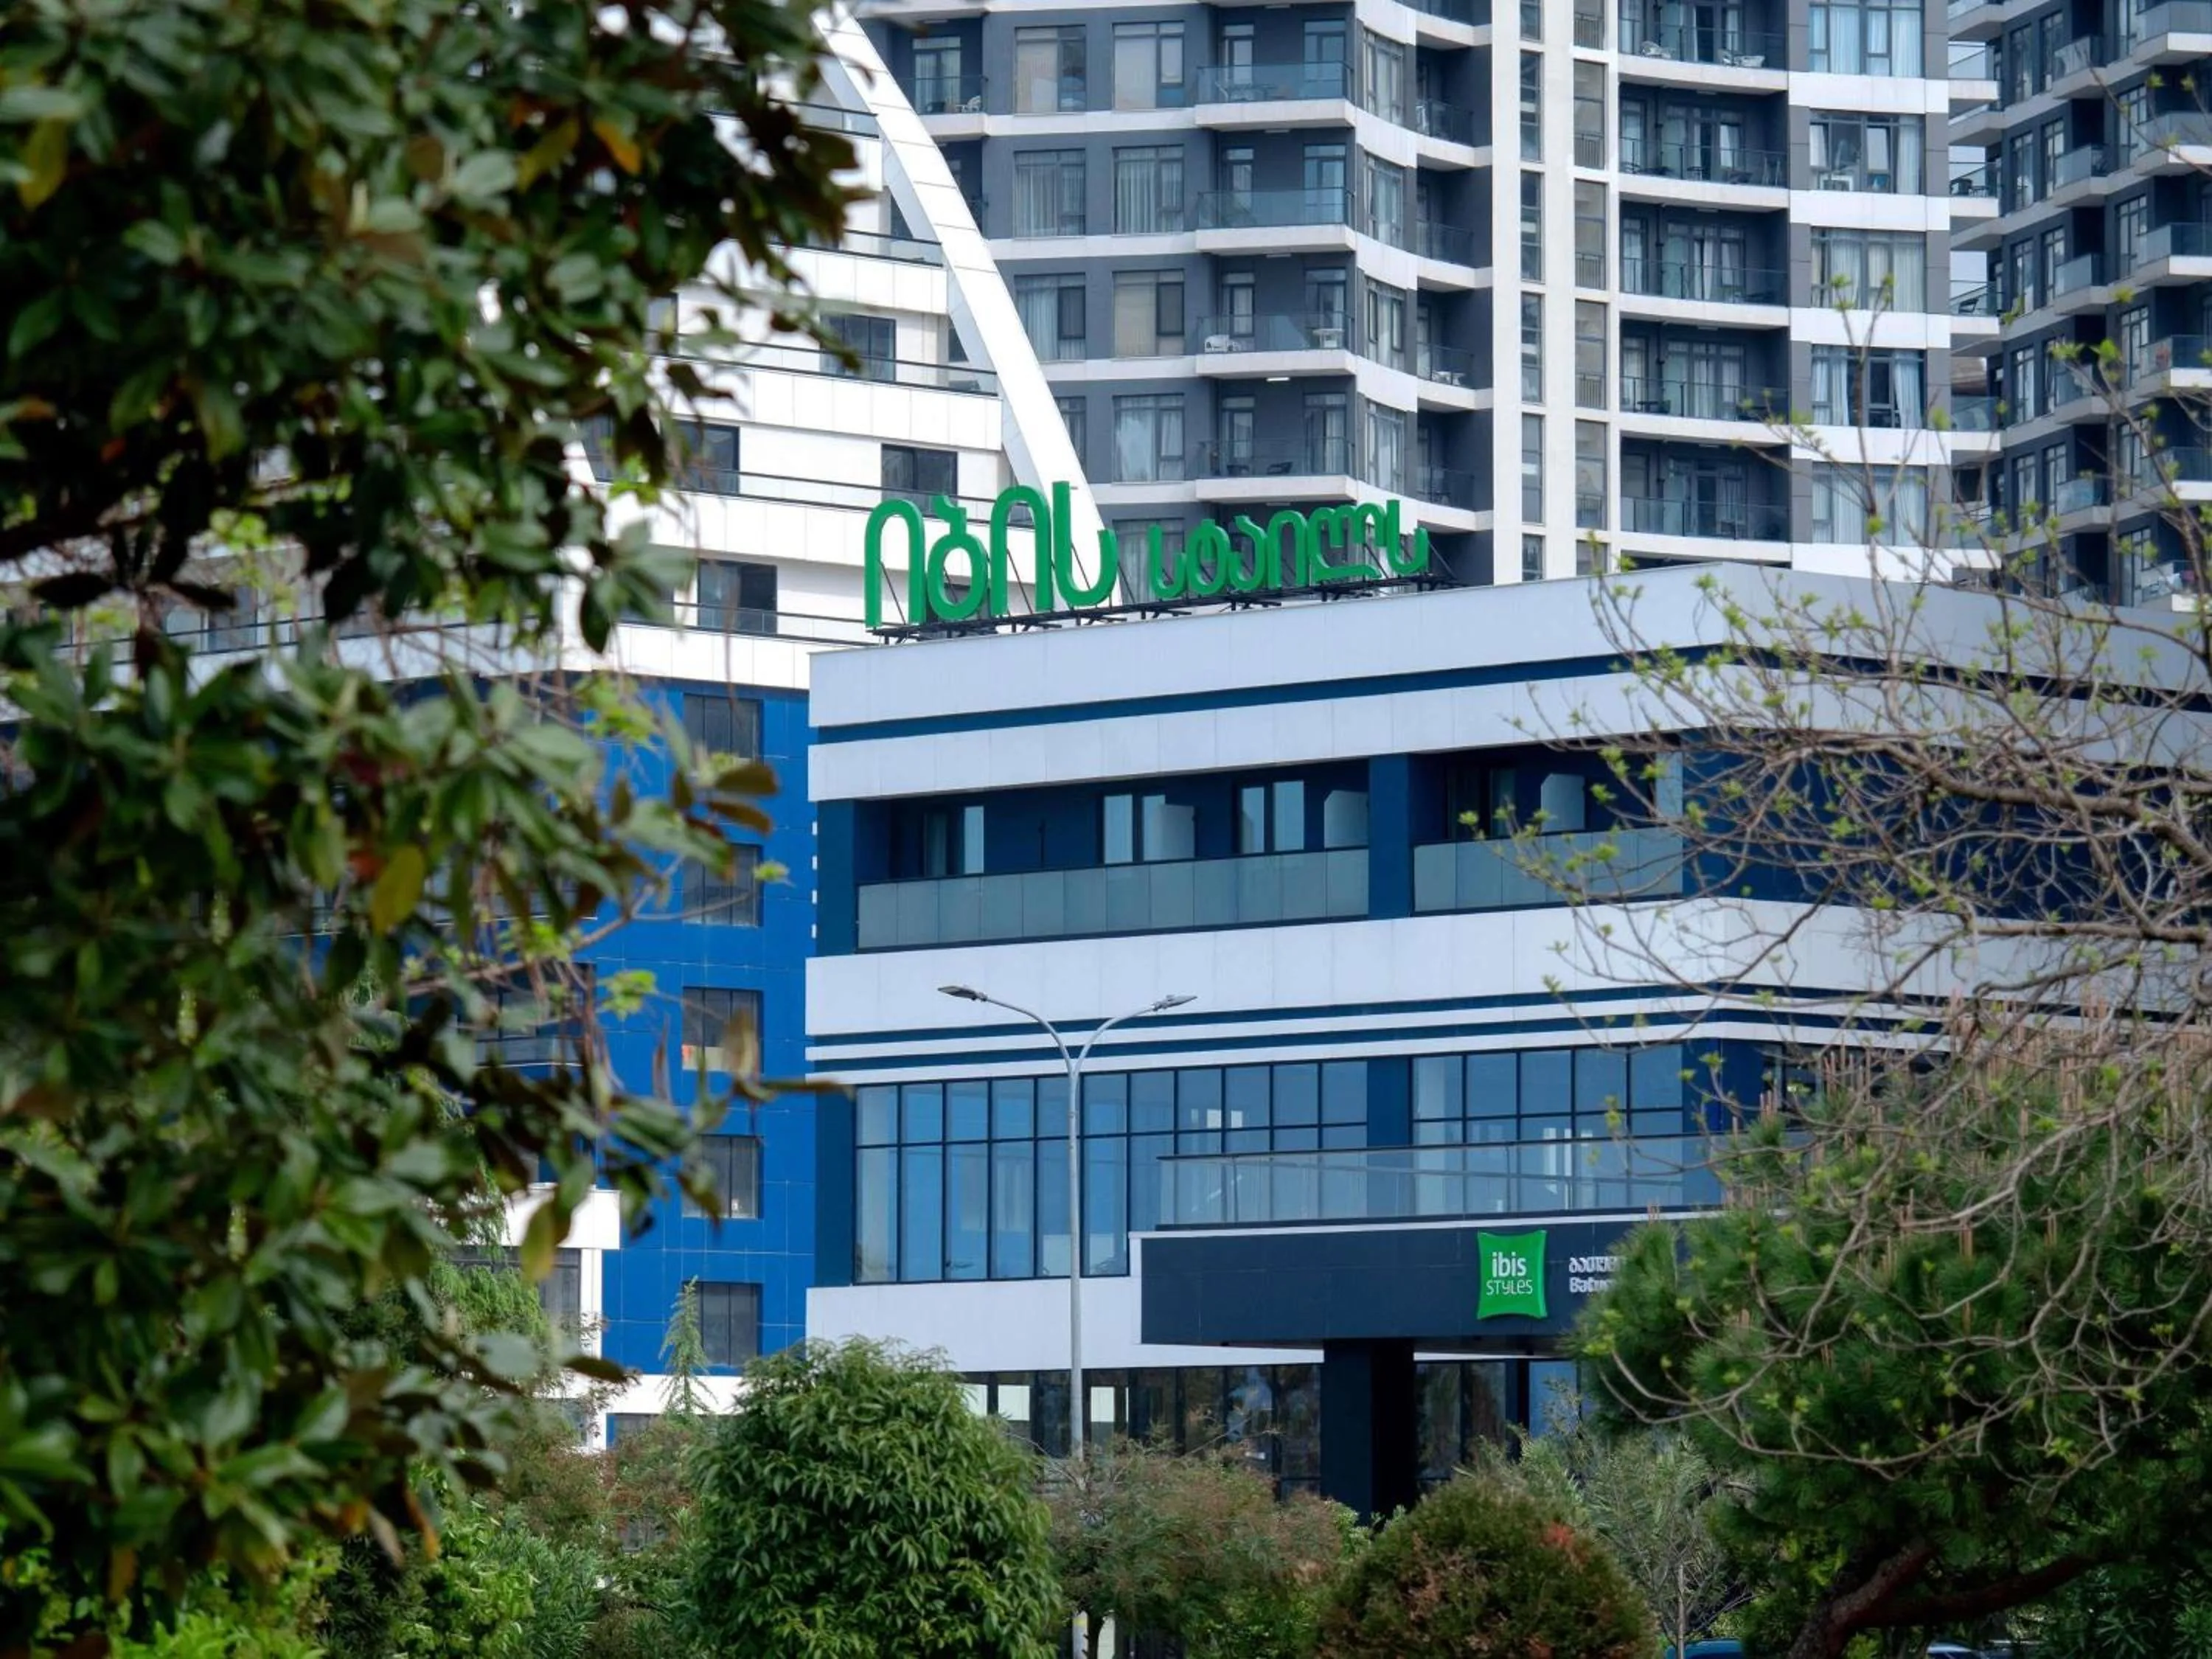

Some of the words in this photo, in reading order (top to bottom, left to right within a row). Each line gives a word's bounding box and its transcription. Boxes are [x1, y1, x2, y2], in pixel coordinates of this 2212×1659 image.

[864, 481, 1120, 628] იბის
[1147, 499, 1430, 600] სტაილს
[1492, 1251, 1526, 1278] ibis
